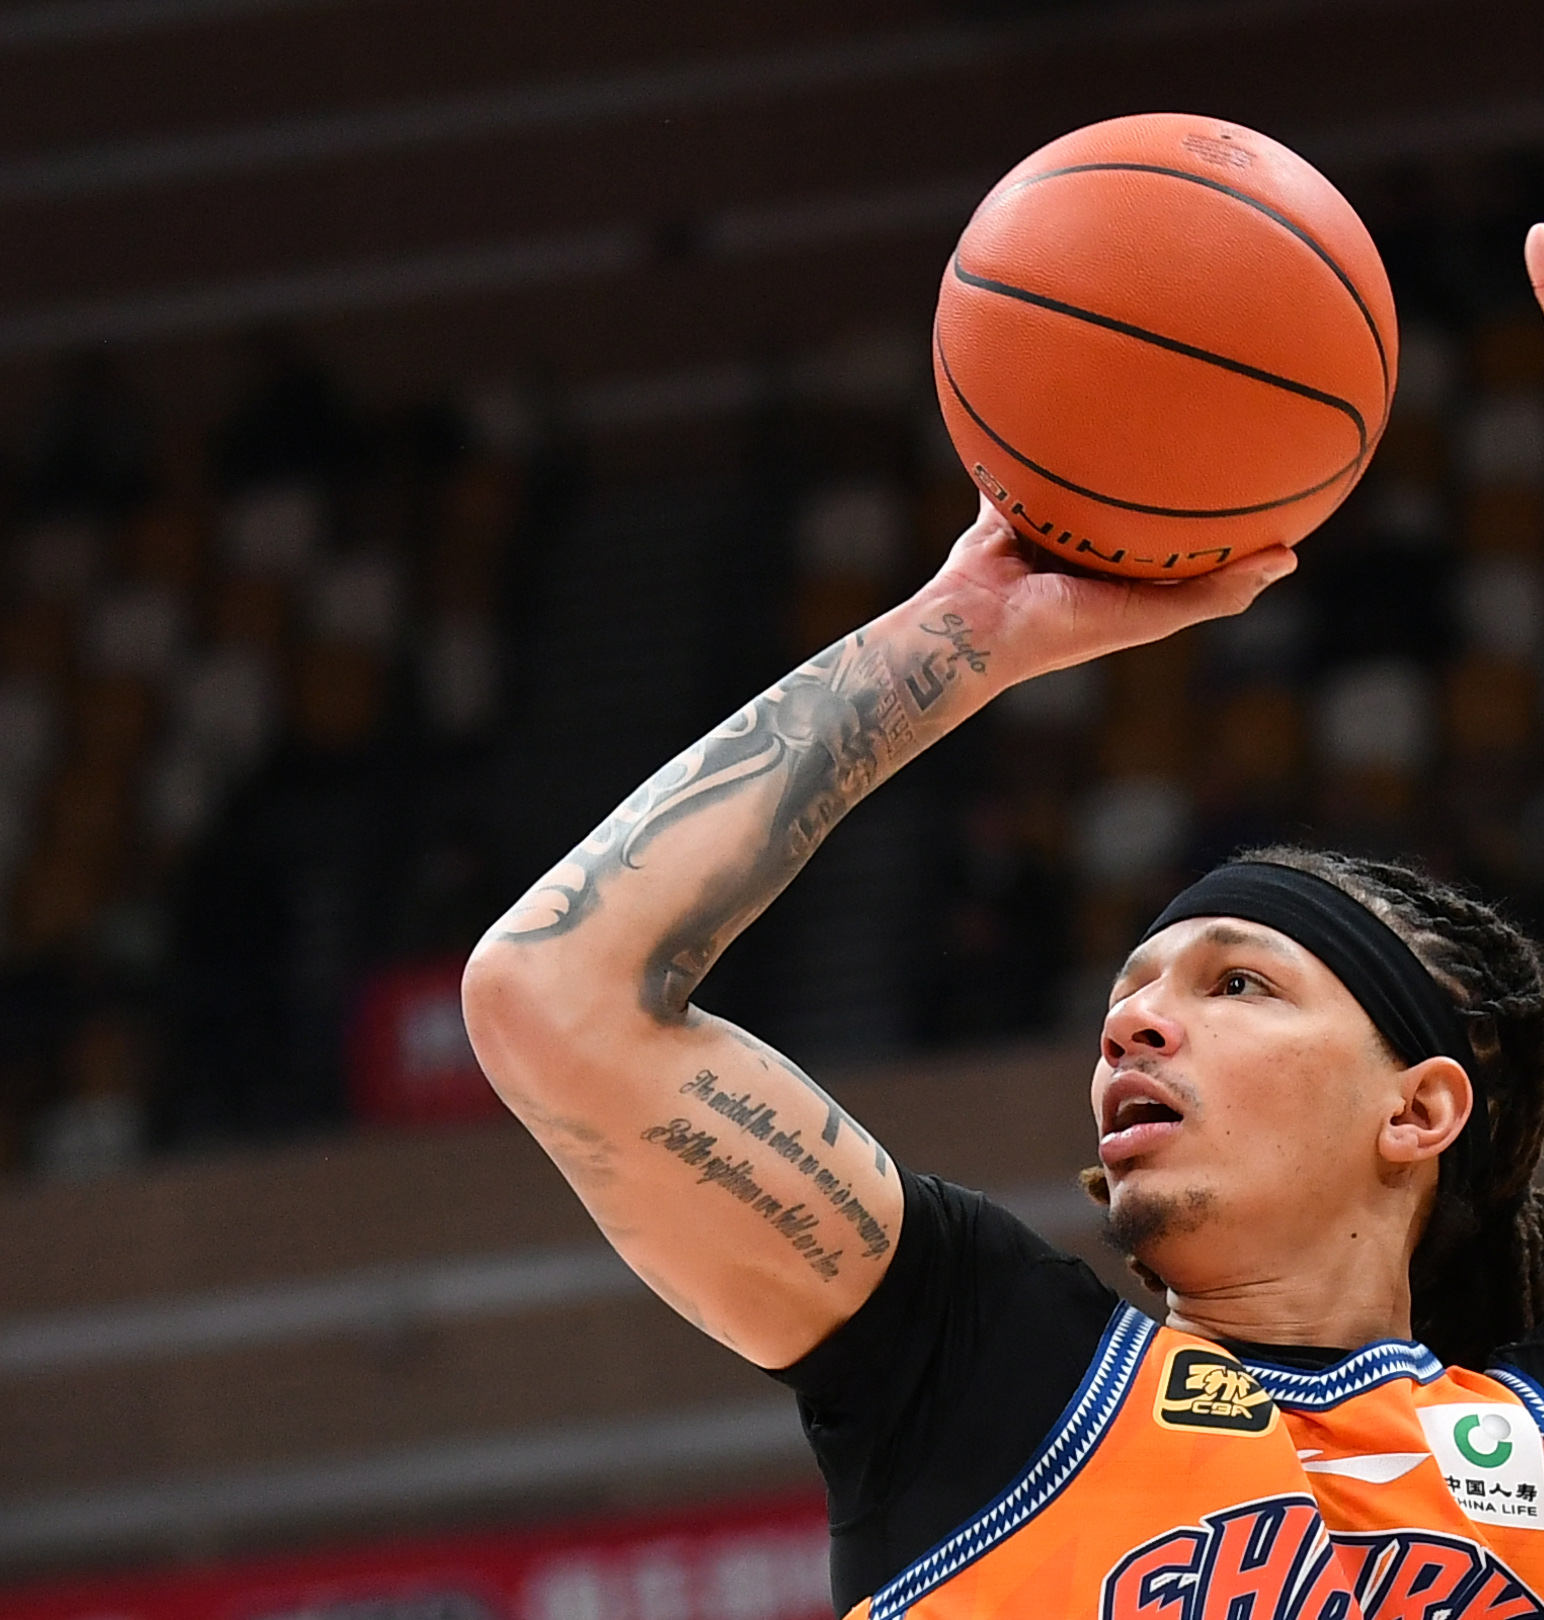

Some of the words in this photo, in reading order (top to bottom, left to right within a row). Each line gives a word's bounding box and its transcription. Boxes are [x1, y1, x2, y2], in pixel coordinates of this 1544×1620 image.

[972, 461, 1234, 570] LI-NING
[1191, 1400, 1253, 1420] CBA
[1444, 1475, 1538, 1503] 中国人寿
[1455, 1497, 1496, 1513] HINA
[1502, 1503, 1538, 1518] LIFE
